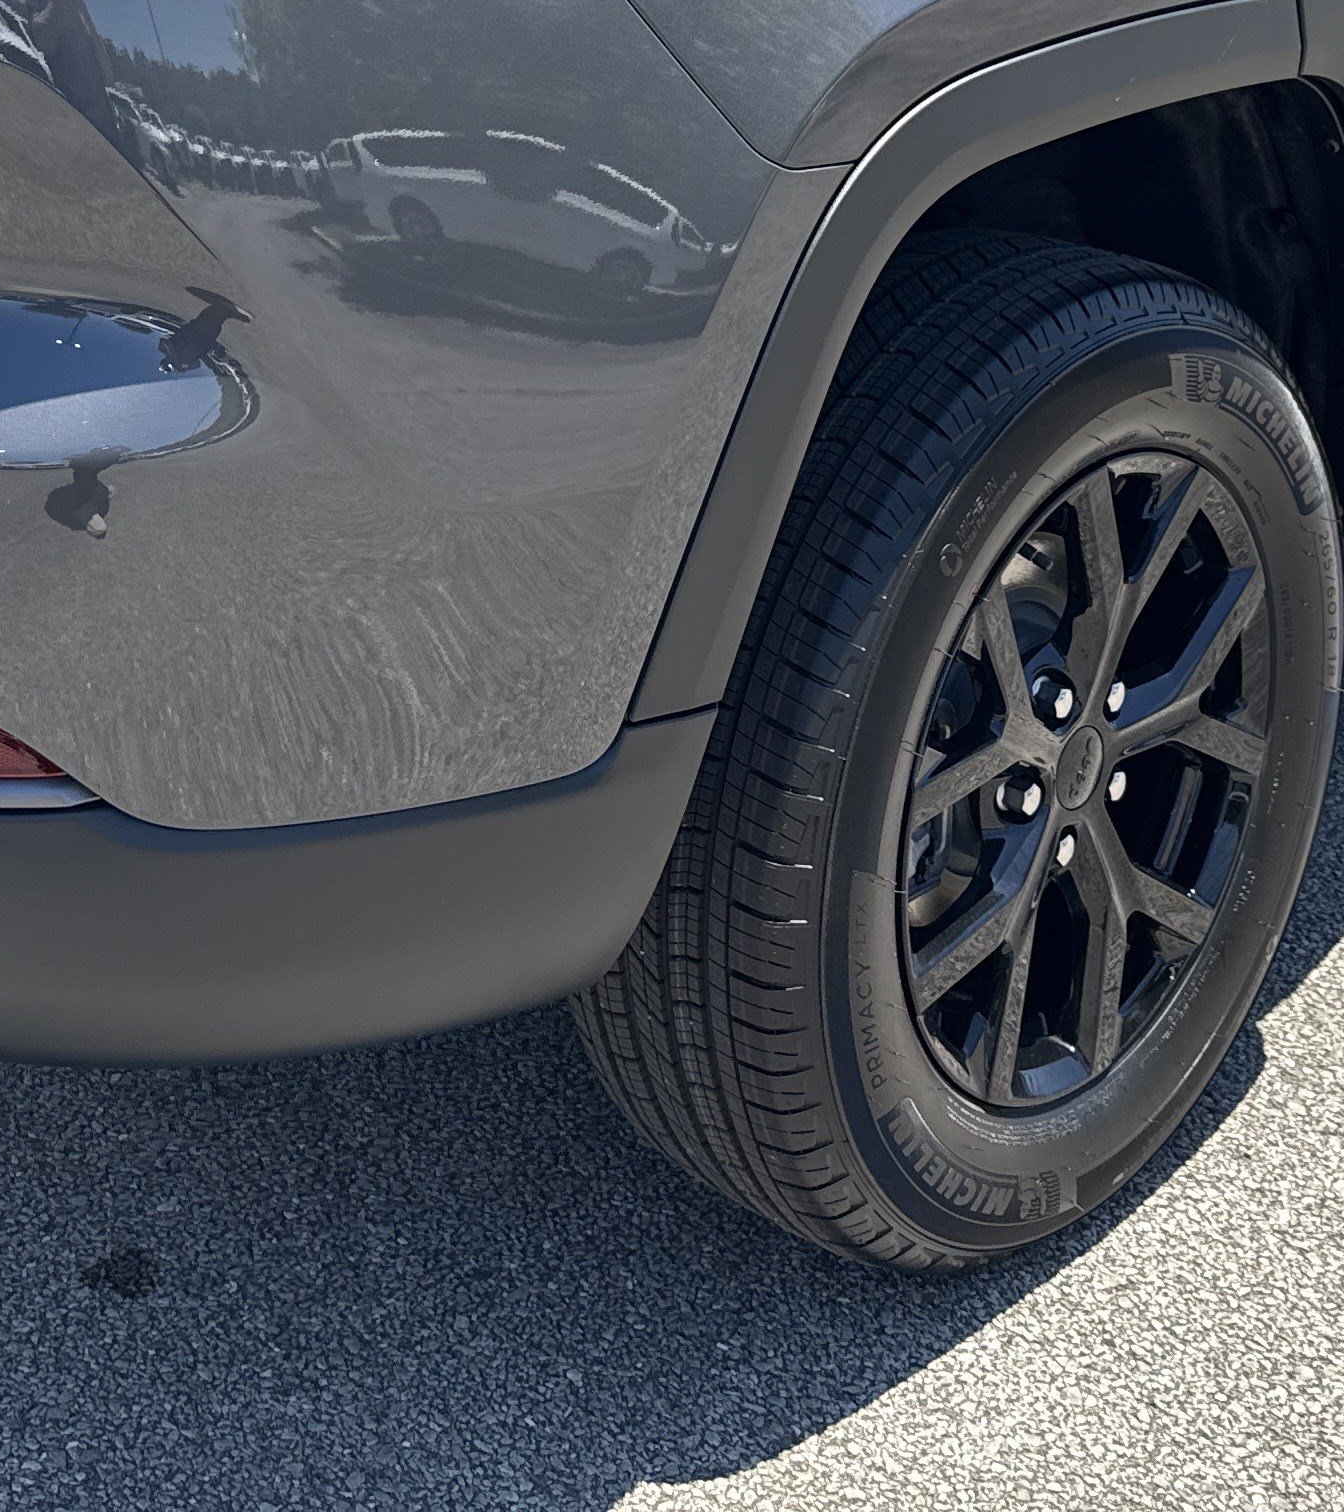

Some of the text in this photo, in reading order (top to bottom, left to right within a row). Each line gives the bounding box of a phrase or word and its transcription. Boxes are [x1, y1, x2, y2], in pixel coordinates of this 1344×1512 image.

[1225, 375, 1324, 504] MICHELIN
[1320, 530, 1337, 615] 265/60
[854, 957, 888, 1090] PRIMACY
[885, 1109, 1014, 1216] MICHELIN
